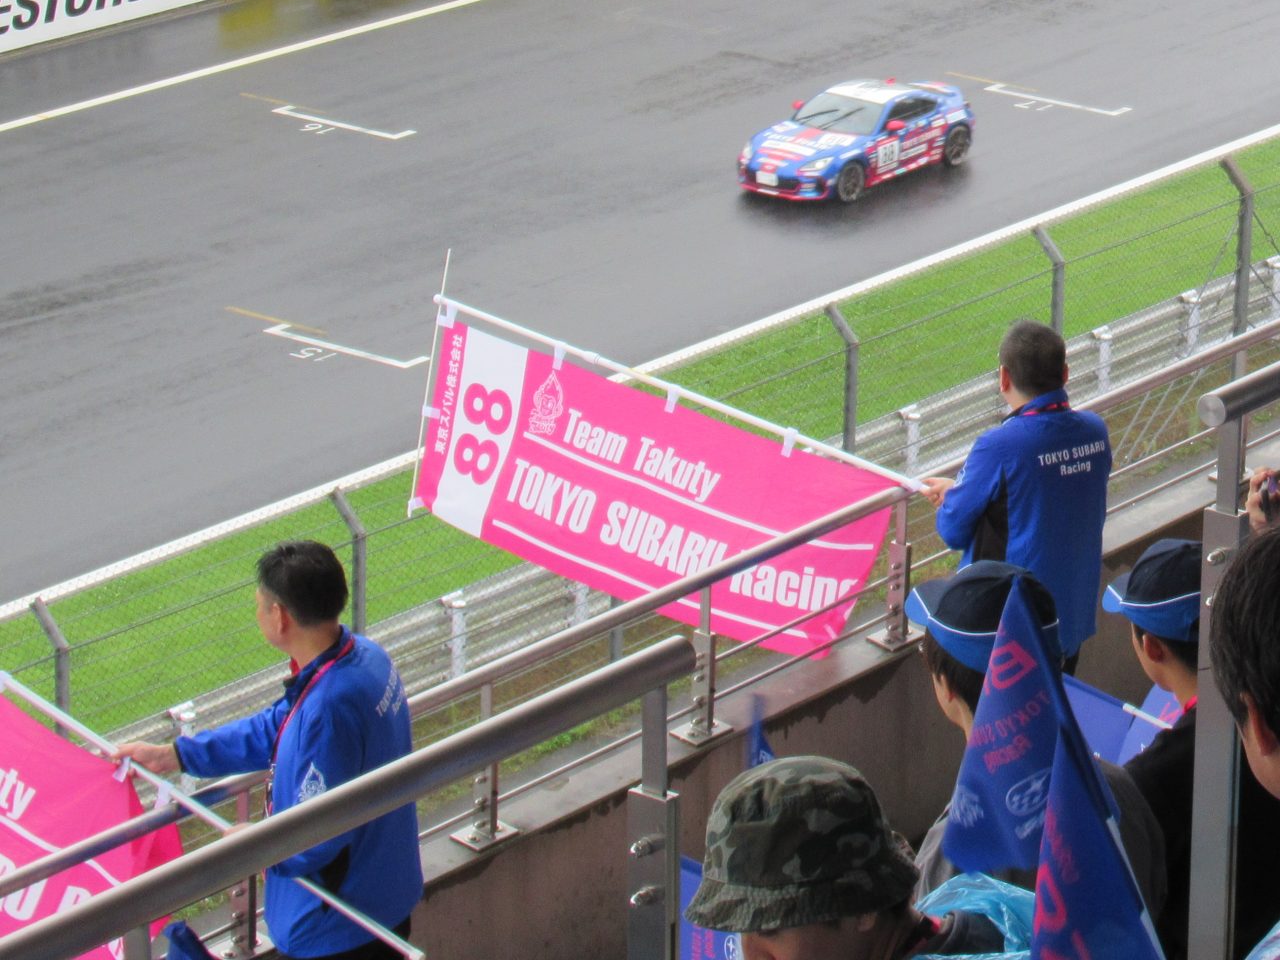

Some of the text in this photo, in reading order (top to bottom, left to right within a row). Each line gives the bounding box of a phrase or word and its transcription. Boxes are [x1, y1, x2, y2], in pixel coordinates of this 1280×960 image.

[434, 333, 463, 456] 東京スバル株式会社
[453, 382, 513, 486] 88
[562, 407, 722, 504] Team Takuty
[1038, 440, 1105, 467] TOKYO SUBARU
[1060, 460, 1092, 476] Racing
[505, 458, 597, 535] TOKYO
[601, 501, 728, 578] SUBARU
